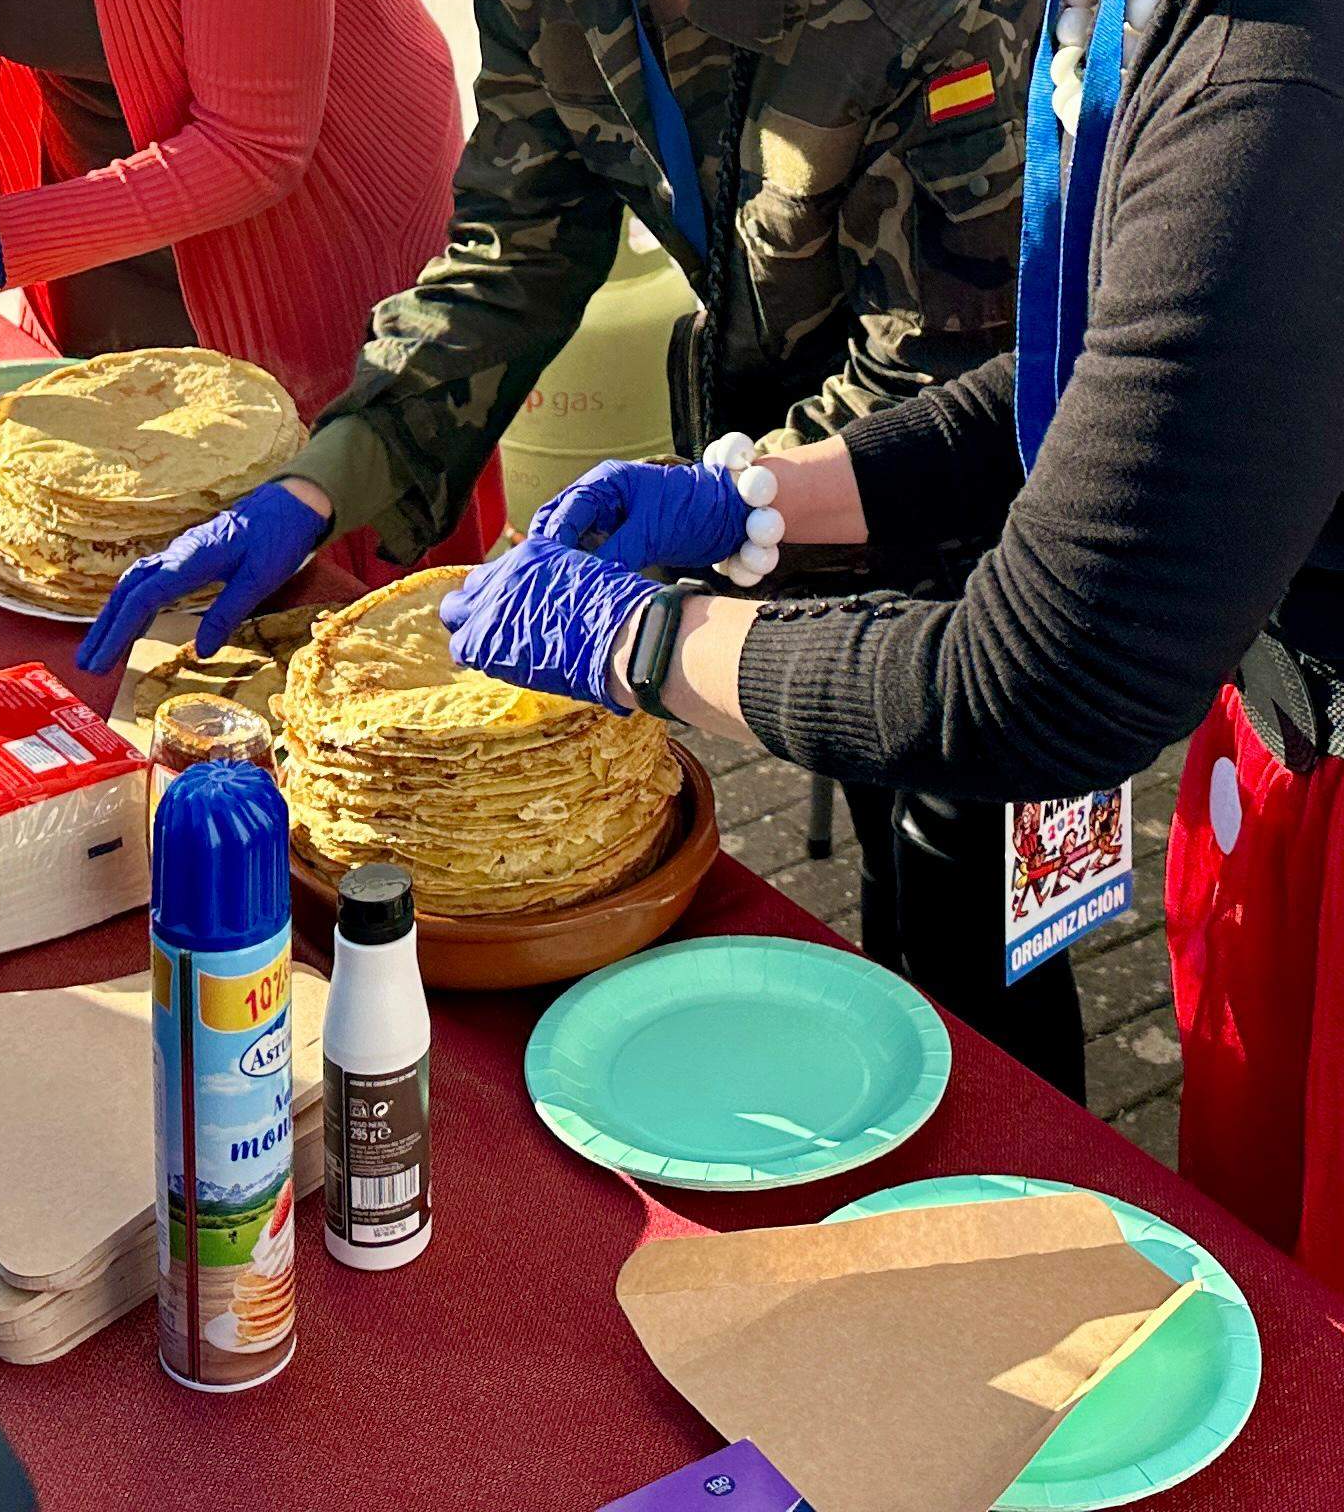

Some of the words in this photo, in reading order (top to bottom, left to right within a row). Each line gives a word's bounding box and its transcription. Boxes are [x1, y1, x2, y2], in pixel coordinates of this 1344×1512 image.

[552, 390, 604, 417] gas
[1011, 881, 1126, 972] ORGANIZACIÓN
[706, 1476, 730, 1491] 100
